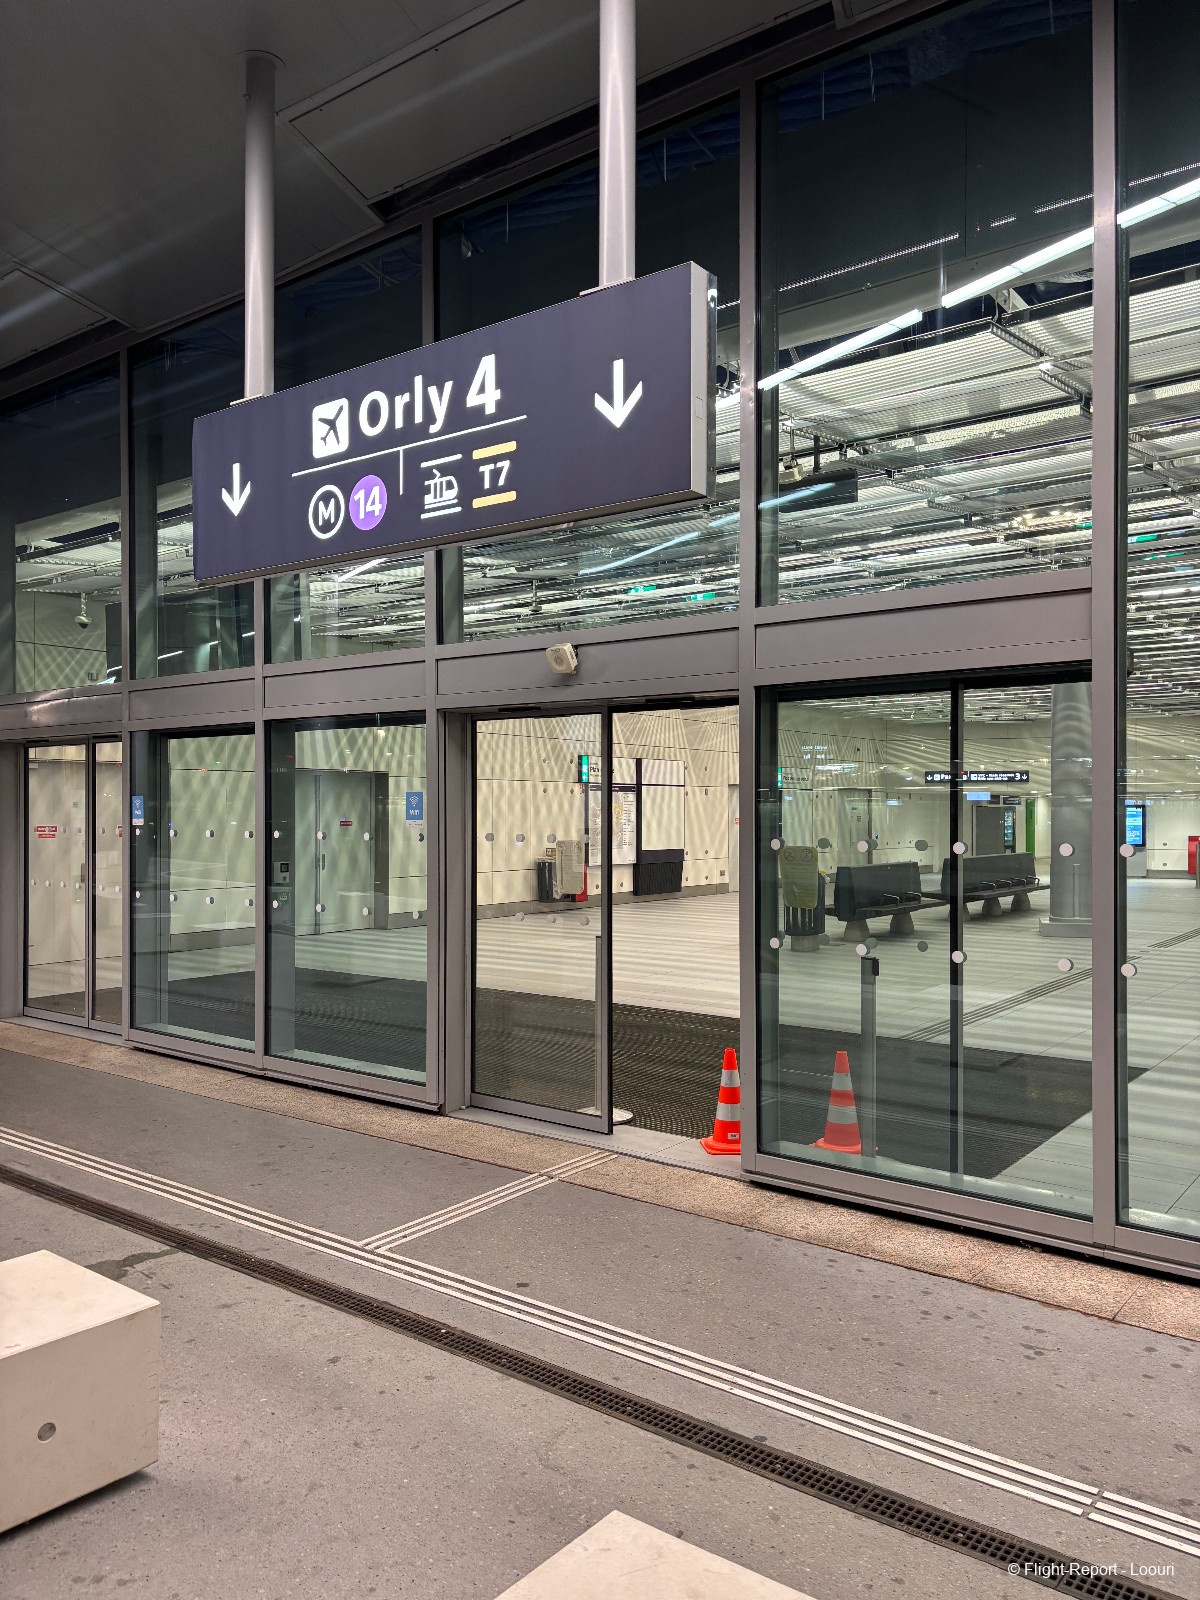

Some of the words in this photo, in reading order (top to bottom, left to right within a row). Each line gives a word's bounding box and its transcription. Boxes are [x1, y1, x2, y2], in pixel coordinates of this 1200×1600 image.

[358, 374, 454, 437] Orly
[465, 353, 502, 416] 4
[479, 460, 511, 489] T7
[353, 485, 382, 520] 14
